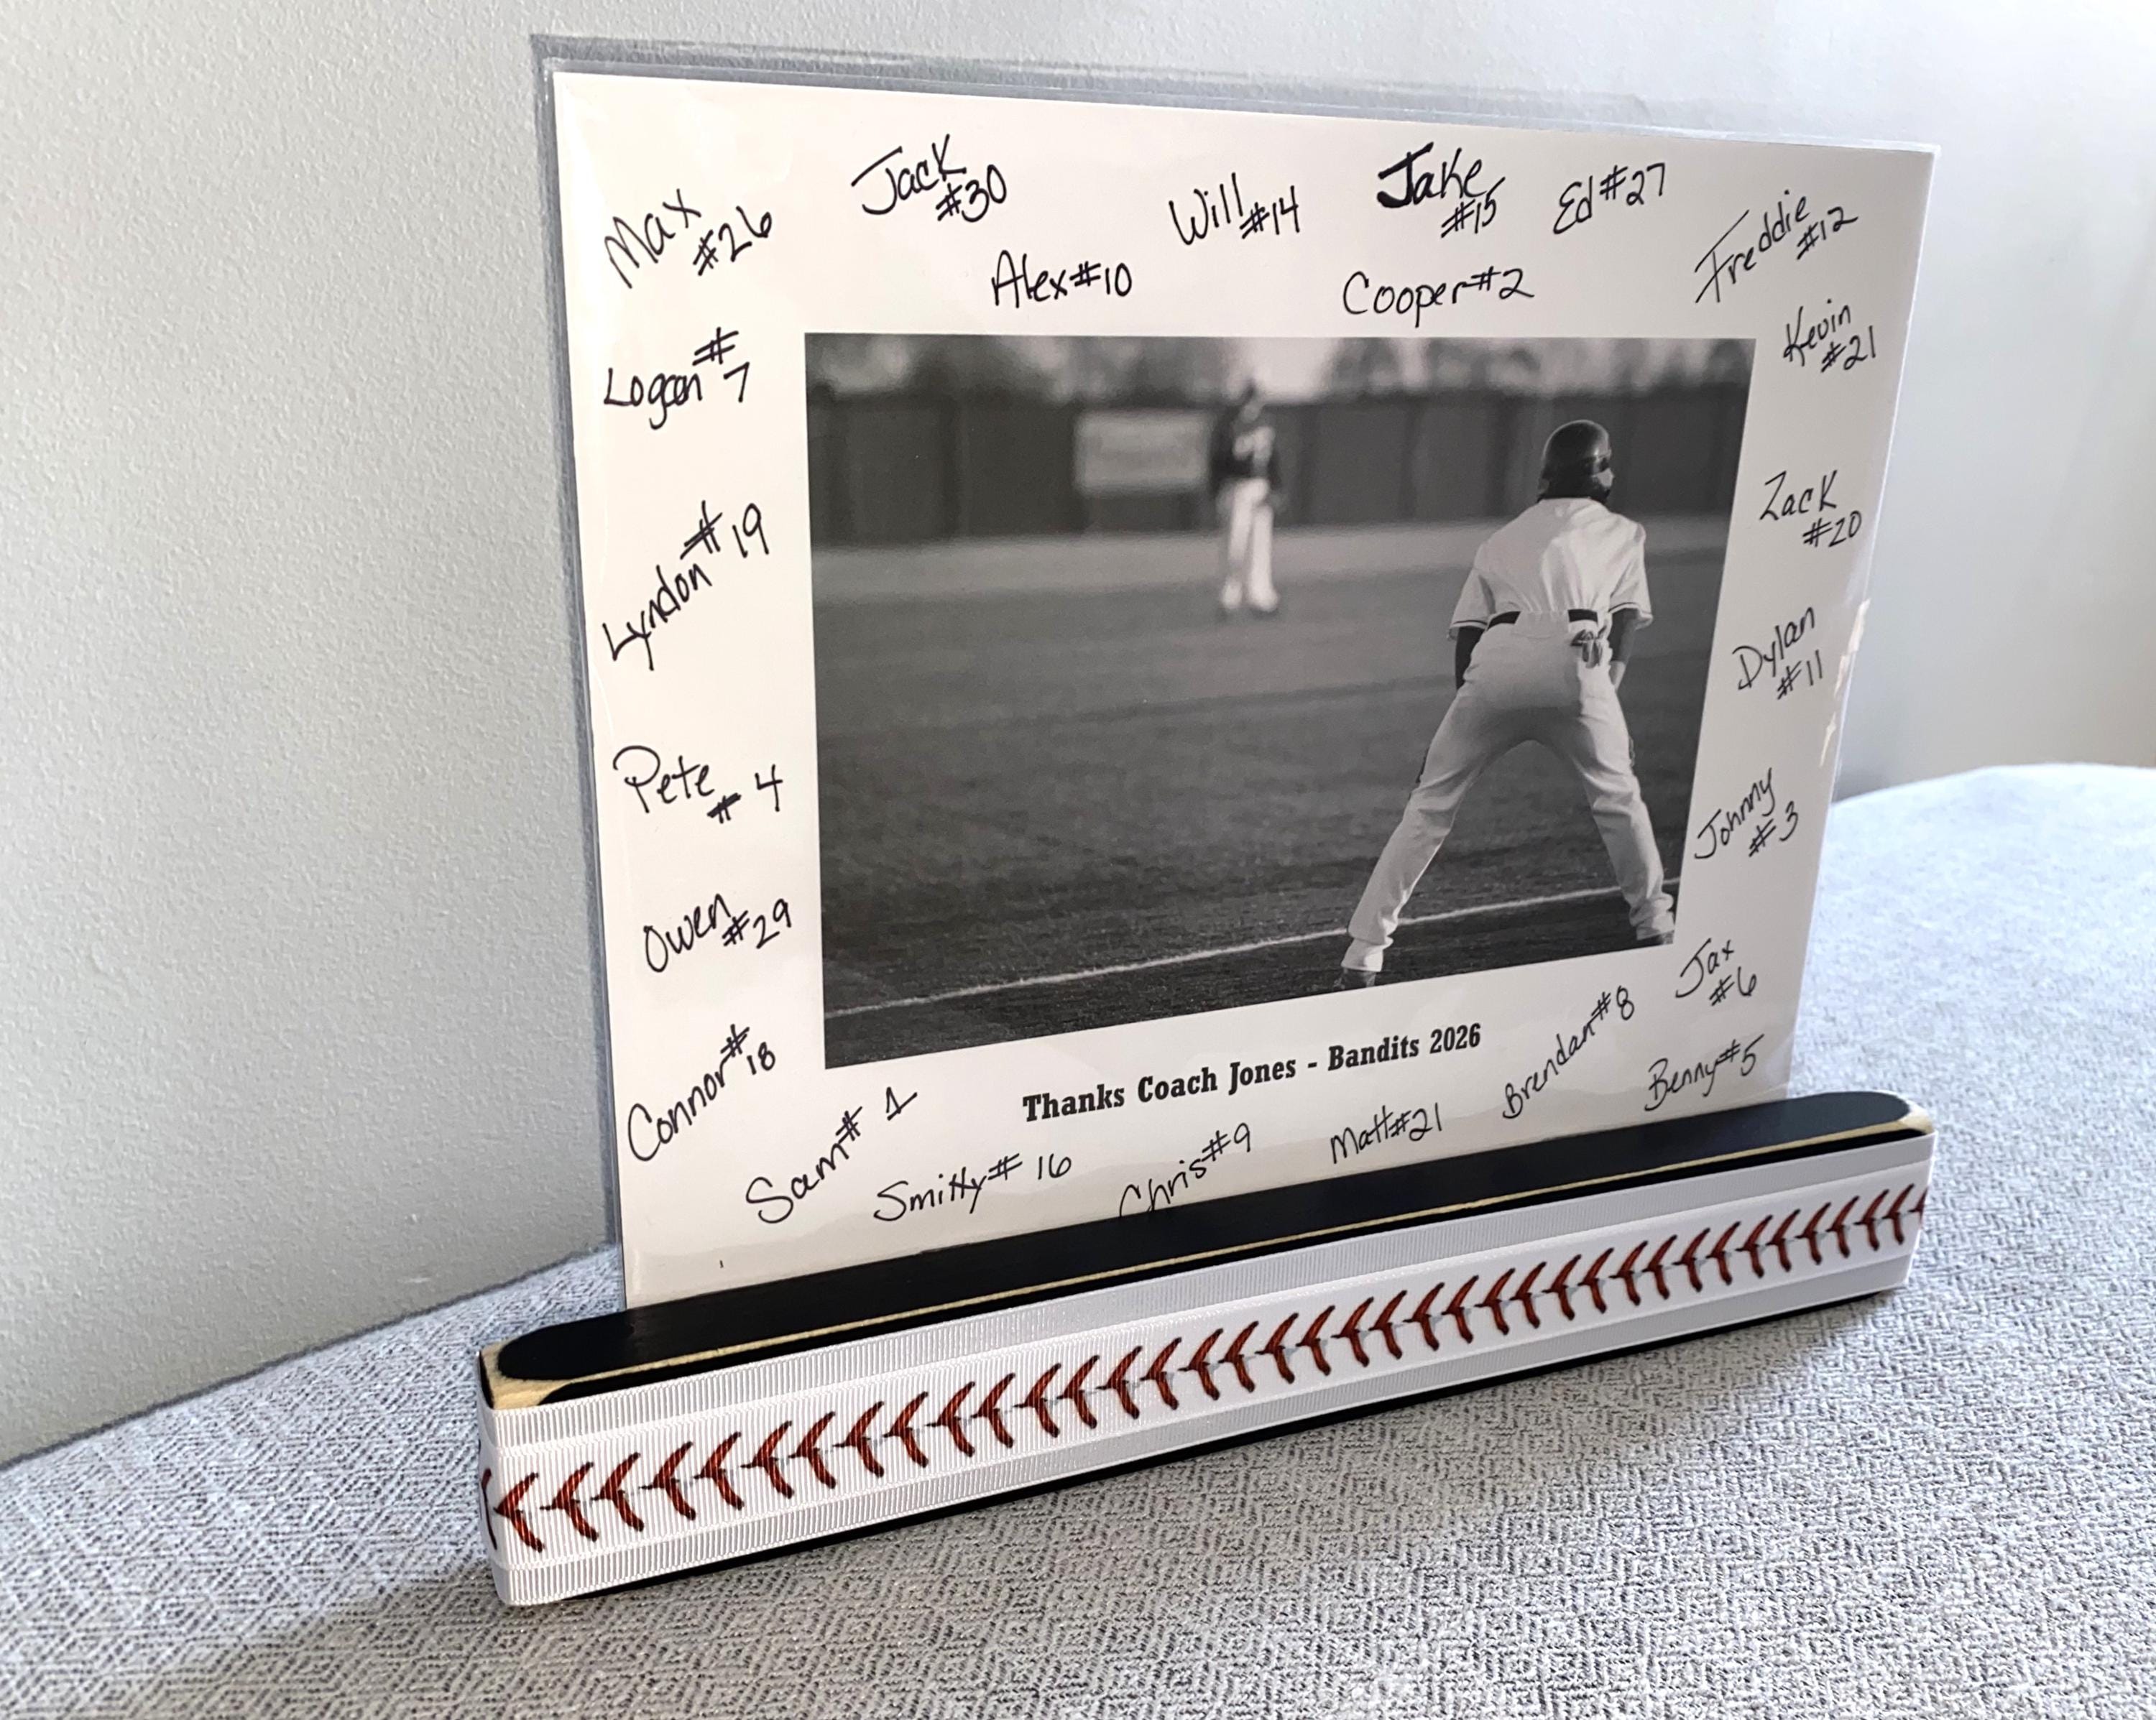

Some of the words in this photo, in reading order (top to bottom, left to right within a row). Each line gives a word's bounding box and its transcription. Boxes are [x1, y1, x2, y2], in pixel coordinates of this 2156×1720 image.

[851, 134, 967, 216] Jack
[935, 164, 1008, 223] #30
[1376, 141, 1487, 209] Jake
[1440, 175, 1506, 239] #15
[604, 188, 702, 290] Max
[691, 205, 773, 277] #26
[1695, 188, 1811, 304] Freddie
[1796, 205, 1859, 261] #12
[1782, 298, 1852, 368] Kevin
[1820, 325, 1877, 374] #21
[603, 366, 703, 431] Logan
[1759, 469, 1838, 522] Zack
[1802, 509, 1862, 548] #20
[1731, 606, 1815, 690] Dylan
[1777, 649, 1824, 701] #11
[612, 744, 716, 814] Pete
[1694, 767, 1777, 860] Johnny
[1748, 800, 1800, 858] #3
[642, 893, 733, 974] Owen
[722, 898, 793, 951] #29
[1674, 938, 1735, 999] Jax
[1708, 966, 1758, 1007] #6
[1022, 1083, 1125, 1122] Thanks
[1137, 1066, 1219, 1104] Coach
[1227, 1057, 1296, 1096] Jones
[1328, 1034, 1420, 1072] Bandits
[1429, 1022, 1482, 1055] 2026
